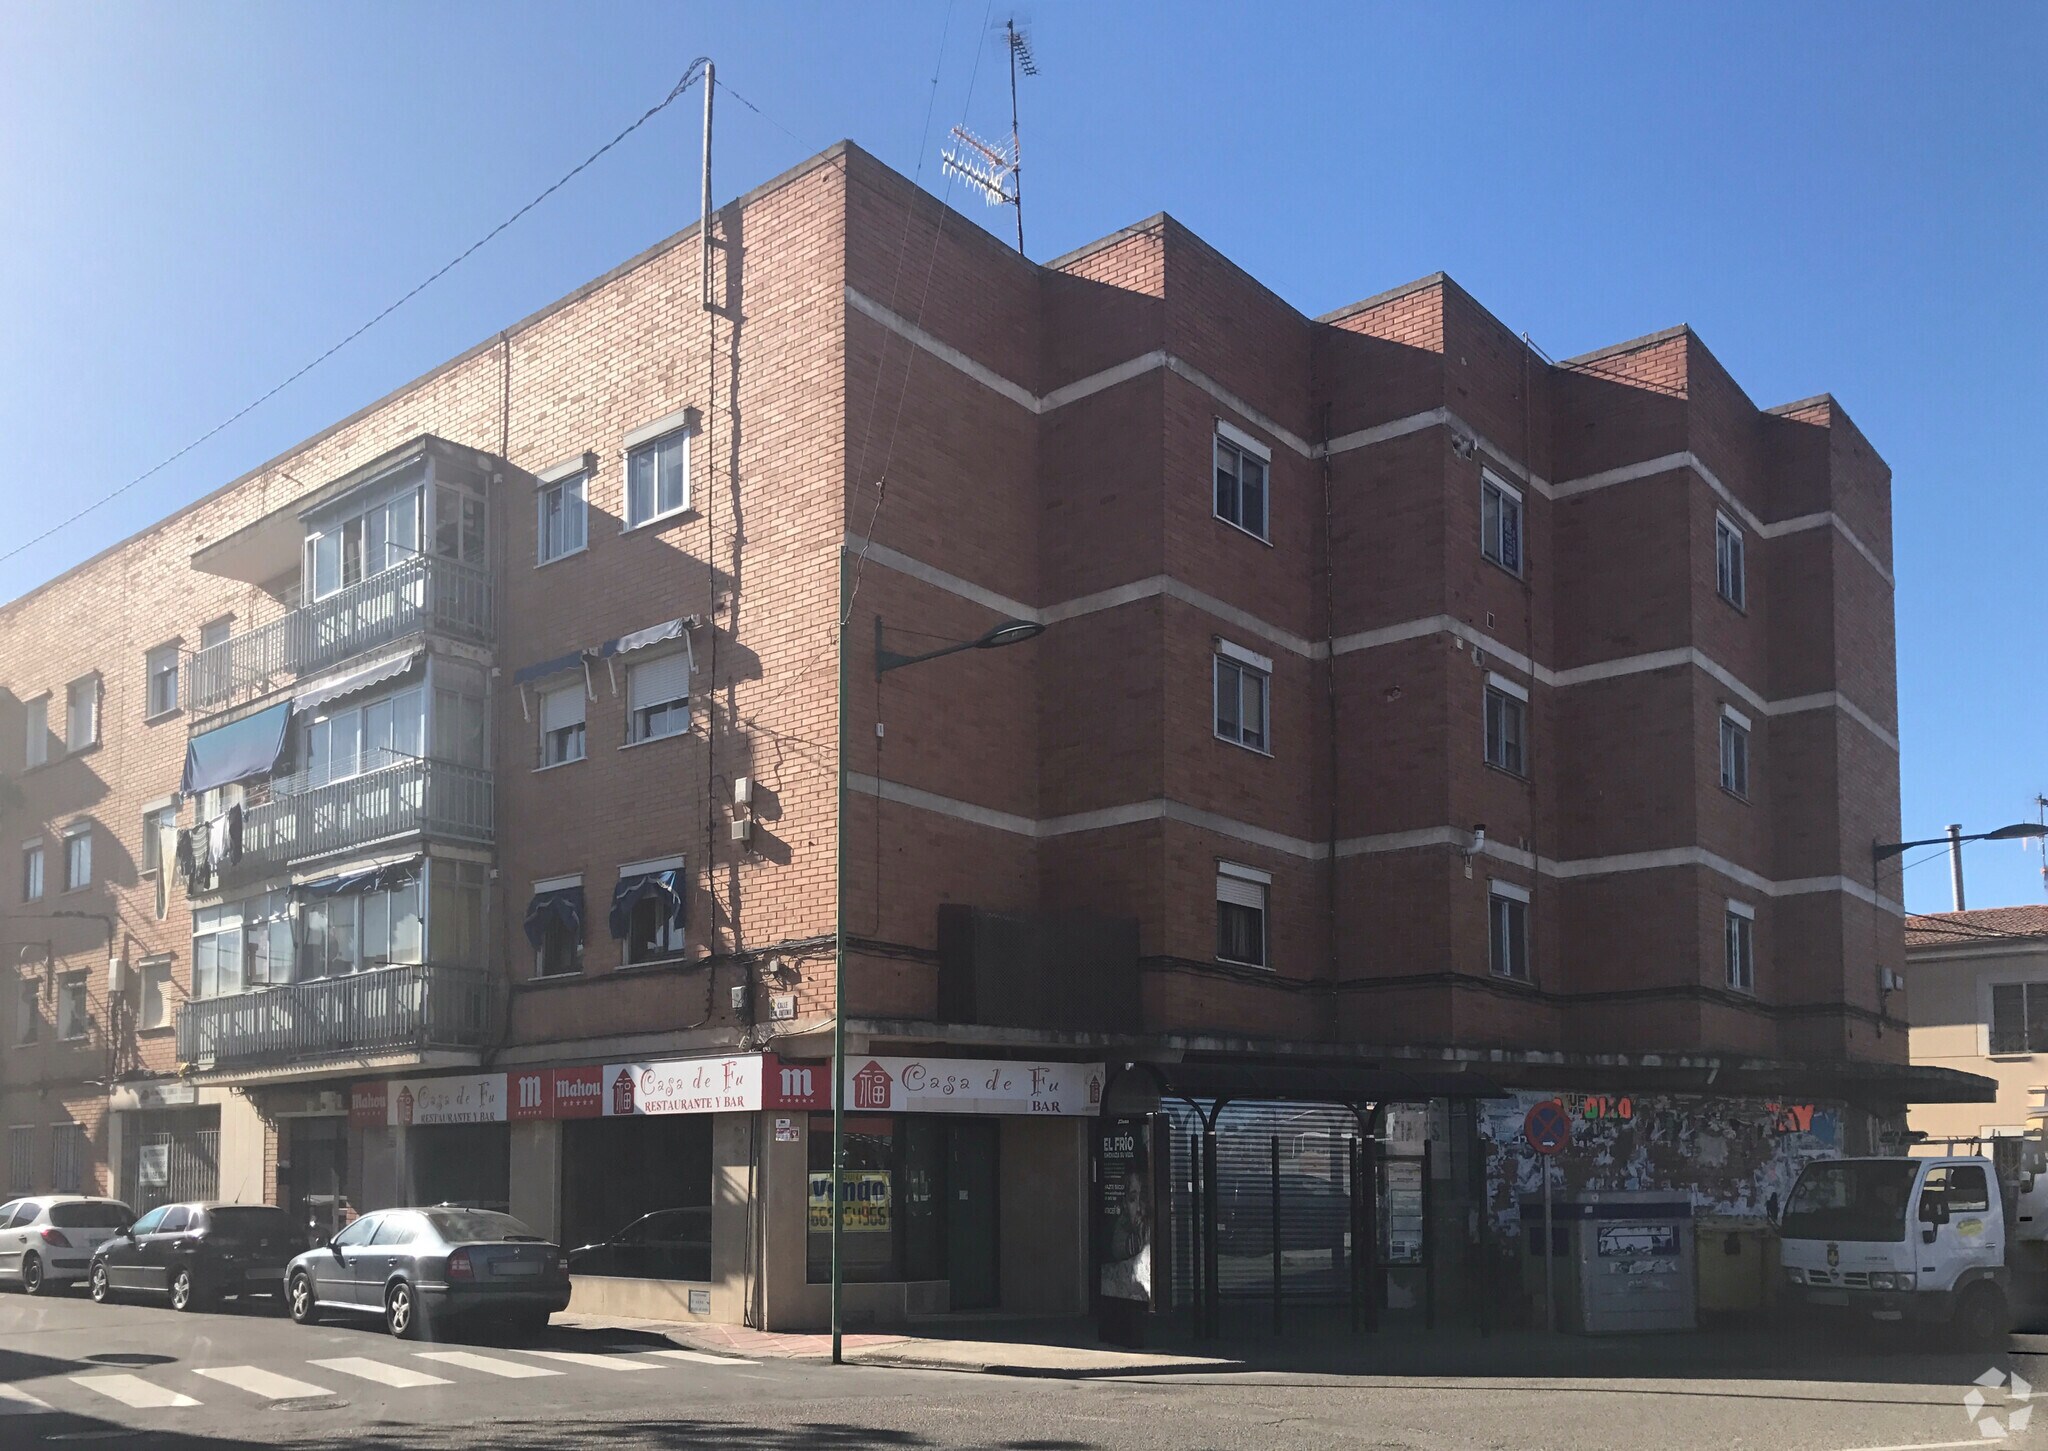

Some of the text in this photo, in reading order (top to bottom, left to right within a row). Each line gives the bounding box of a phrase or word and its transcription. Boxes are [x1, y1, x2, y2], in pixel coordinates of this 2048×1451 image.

[640, 1059, 744, 1097] Casa de Fu
[901, 1062, 971, 1095] Casa
[985, 1068, 1012, 1091] de
[1027, 1065, 1059, 1097] Fu
[418, 1081, 495, 1111] Casa de Fu
[645, 1095, 745, 1113] RESTAURANTE Y BAR
[1031, 1100, 1062, 1113] BAR
[420, 1111, 495, 1123] RESTAURANTE Y BAR
[1103, 1131, 1134, 1152] EL FRÍO
